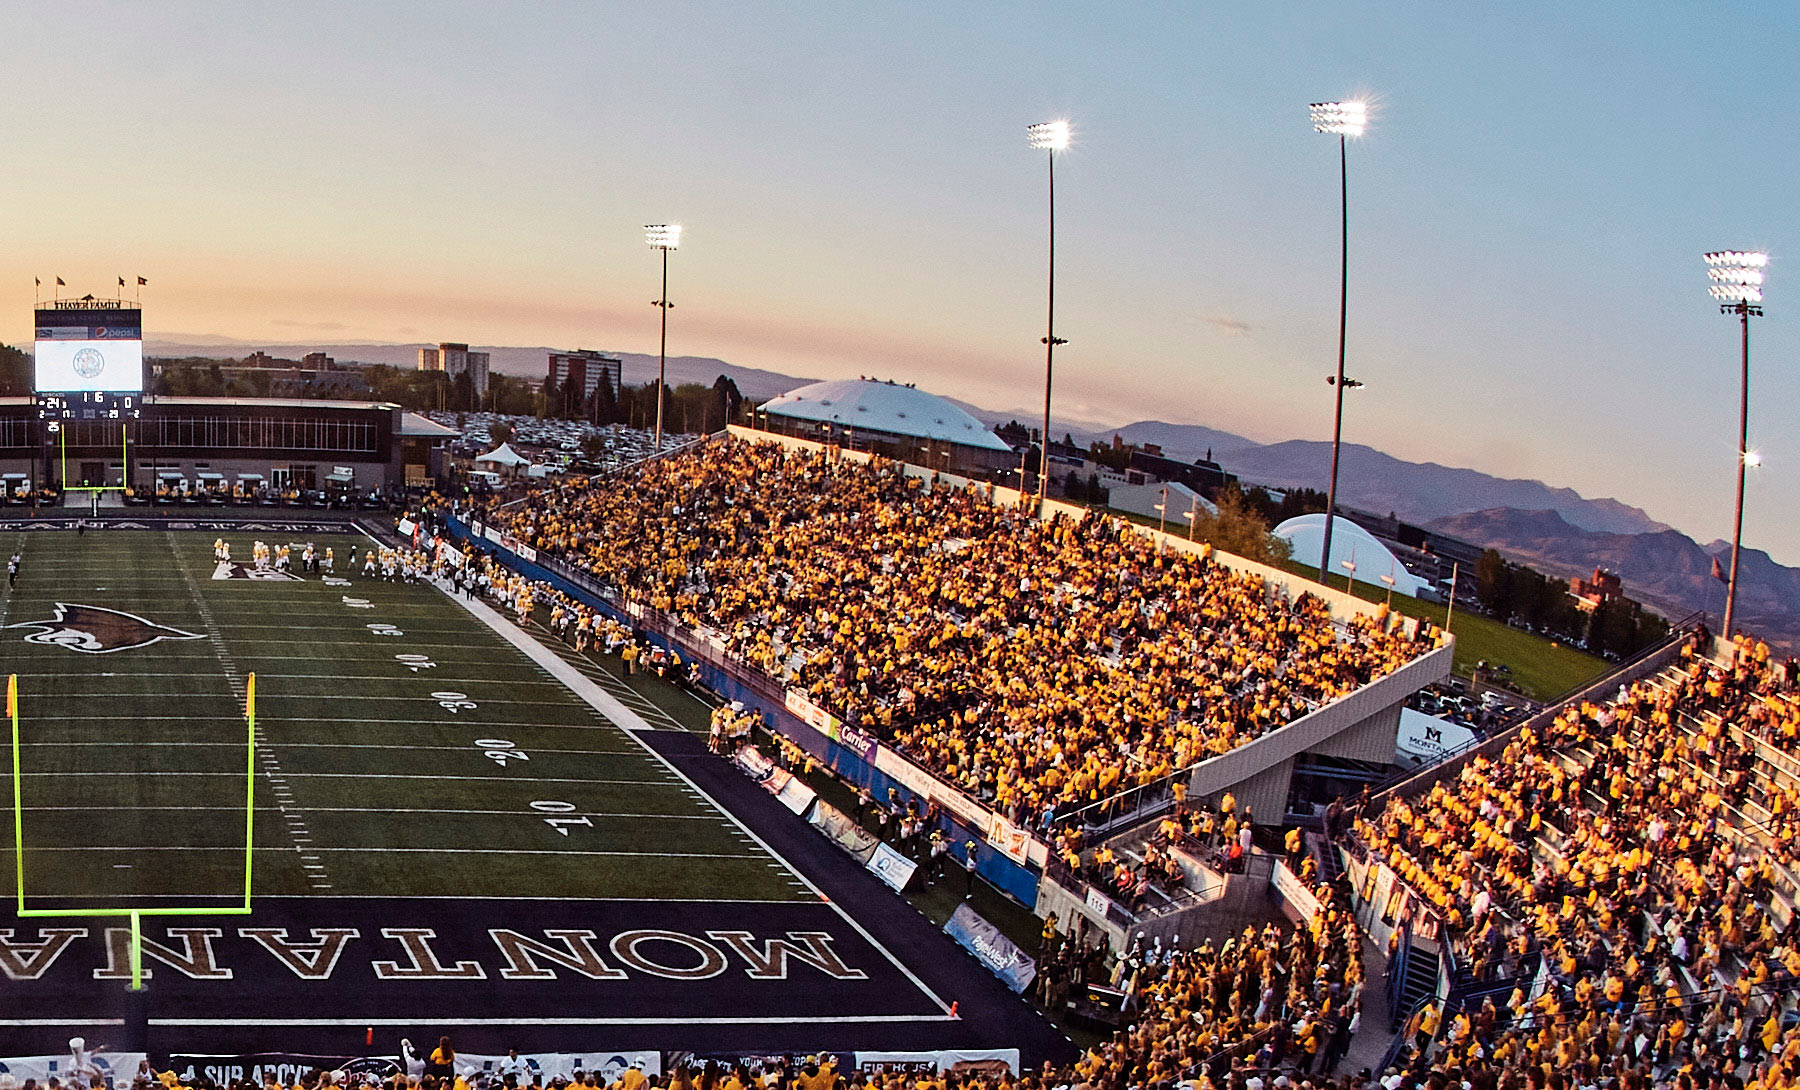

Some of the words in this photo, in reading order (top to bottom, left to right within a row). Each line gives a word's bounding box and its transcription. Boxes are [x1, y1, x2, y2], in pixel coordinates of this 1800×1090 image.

[430, 692, 478, 709] 30
[842, 726, 872, 752] Carrier
[1425, 726, 1442, 743] M
[474, 738, 530, 760] 20
[529, 800, 594, 828] 10
[1091, 896, 1104, 913] 115
[184, 1064, 196, 1080] A
[204, 1064, 244, 1089] SUB
